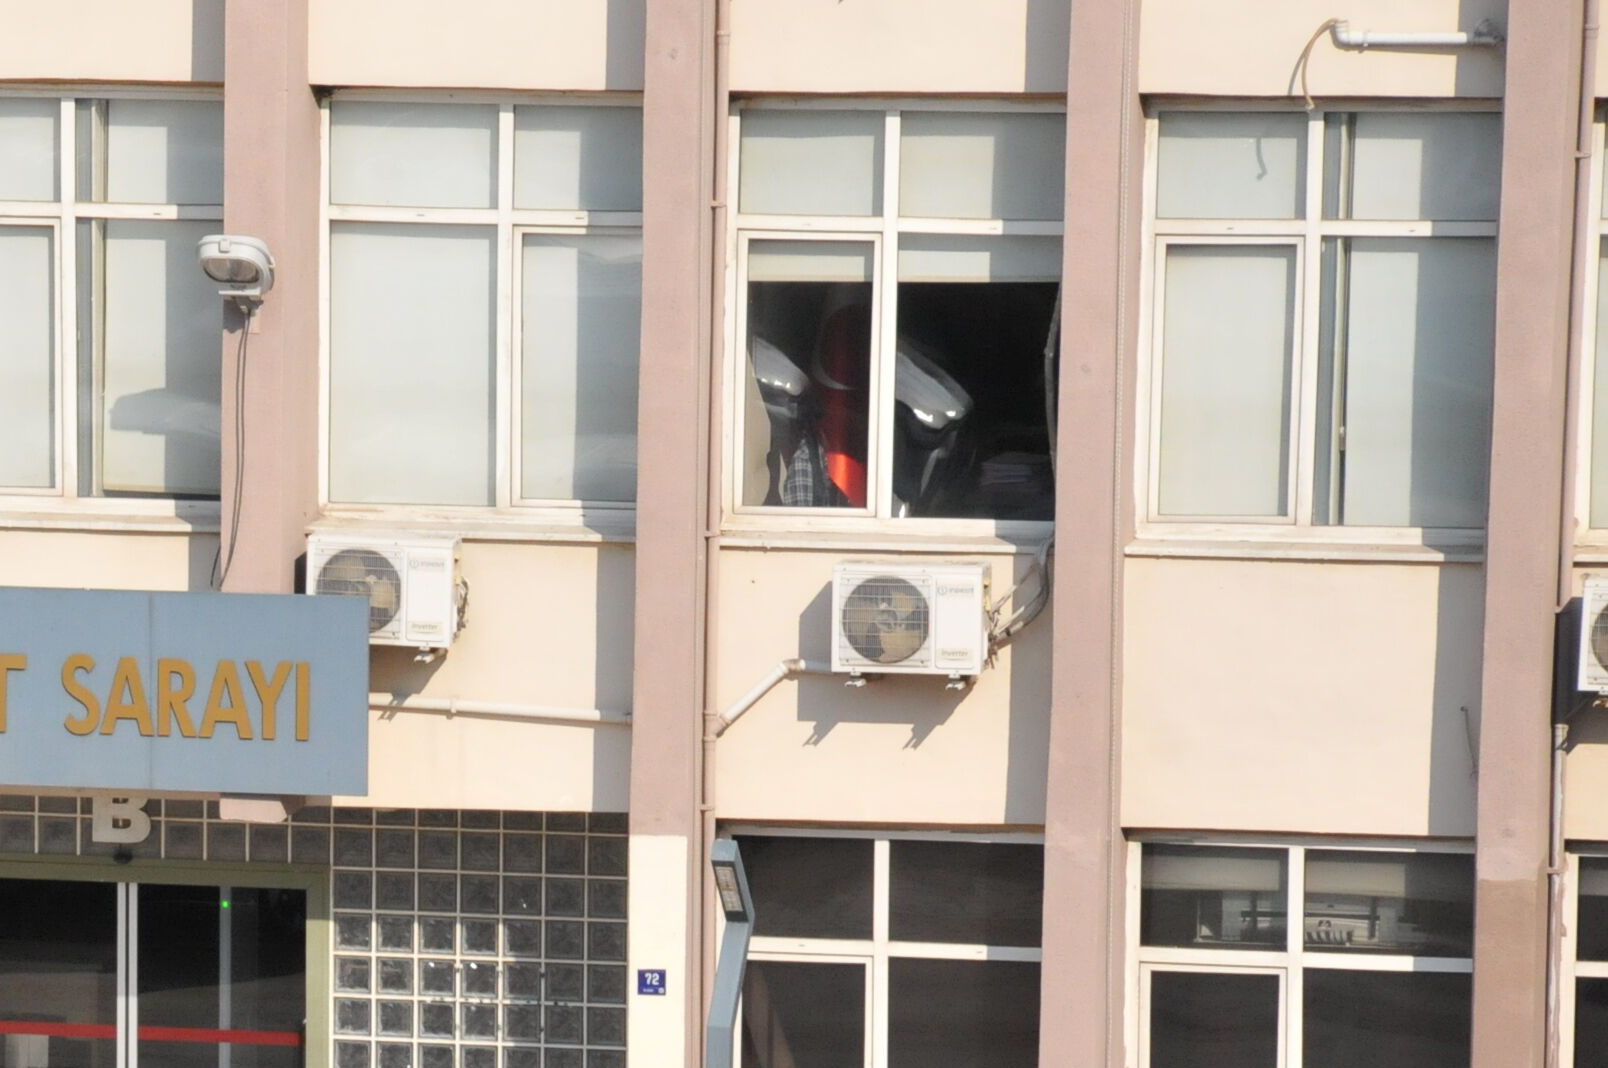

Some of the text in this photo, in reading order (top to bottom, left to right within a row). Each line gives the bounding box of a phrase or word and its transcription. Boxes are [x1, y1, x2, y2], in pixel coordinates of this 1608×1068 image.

[60, 652, 312, 743] SARAYI
[92, 797, 152, 844] B
[644, 972, 660, 986] 72
